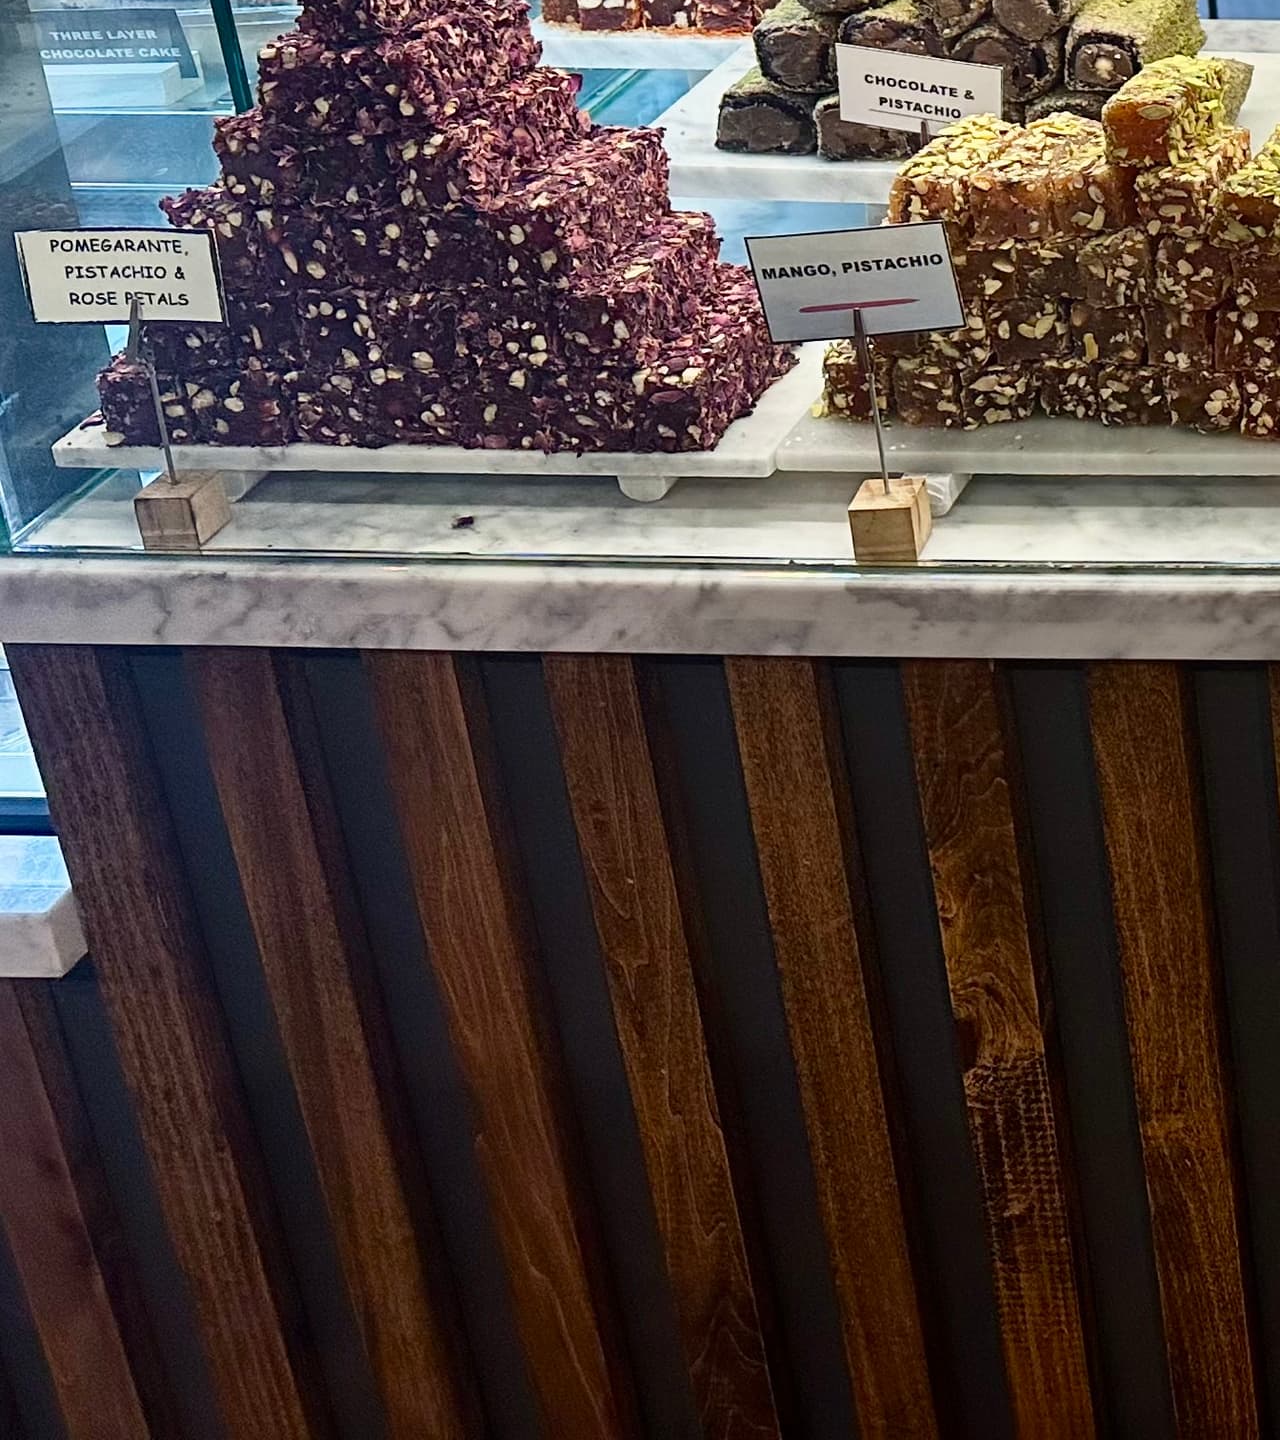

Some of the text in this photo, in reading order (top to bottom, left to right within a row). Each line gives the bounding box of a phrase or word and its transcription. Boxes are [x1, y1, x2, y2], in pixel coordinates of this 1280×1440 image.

[49, 29, 158, 41] THREE LAYER
[39, 46, 182, 60] CHOCOLATE CAKE
[864, 73, 976, 101] CHOCOLATE &
[878, 96, 962, 119] PISTACHIO
[49, 238, 189, 256] POMEGARANTE,
[64, 265, 186, 280] PISTACHIO &
[761, 253, 944, 280] MANGO, PISTACHIO
[69, 291, 190, 306] ROSE PETALS
